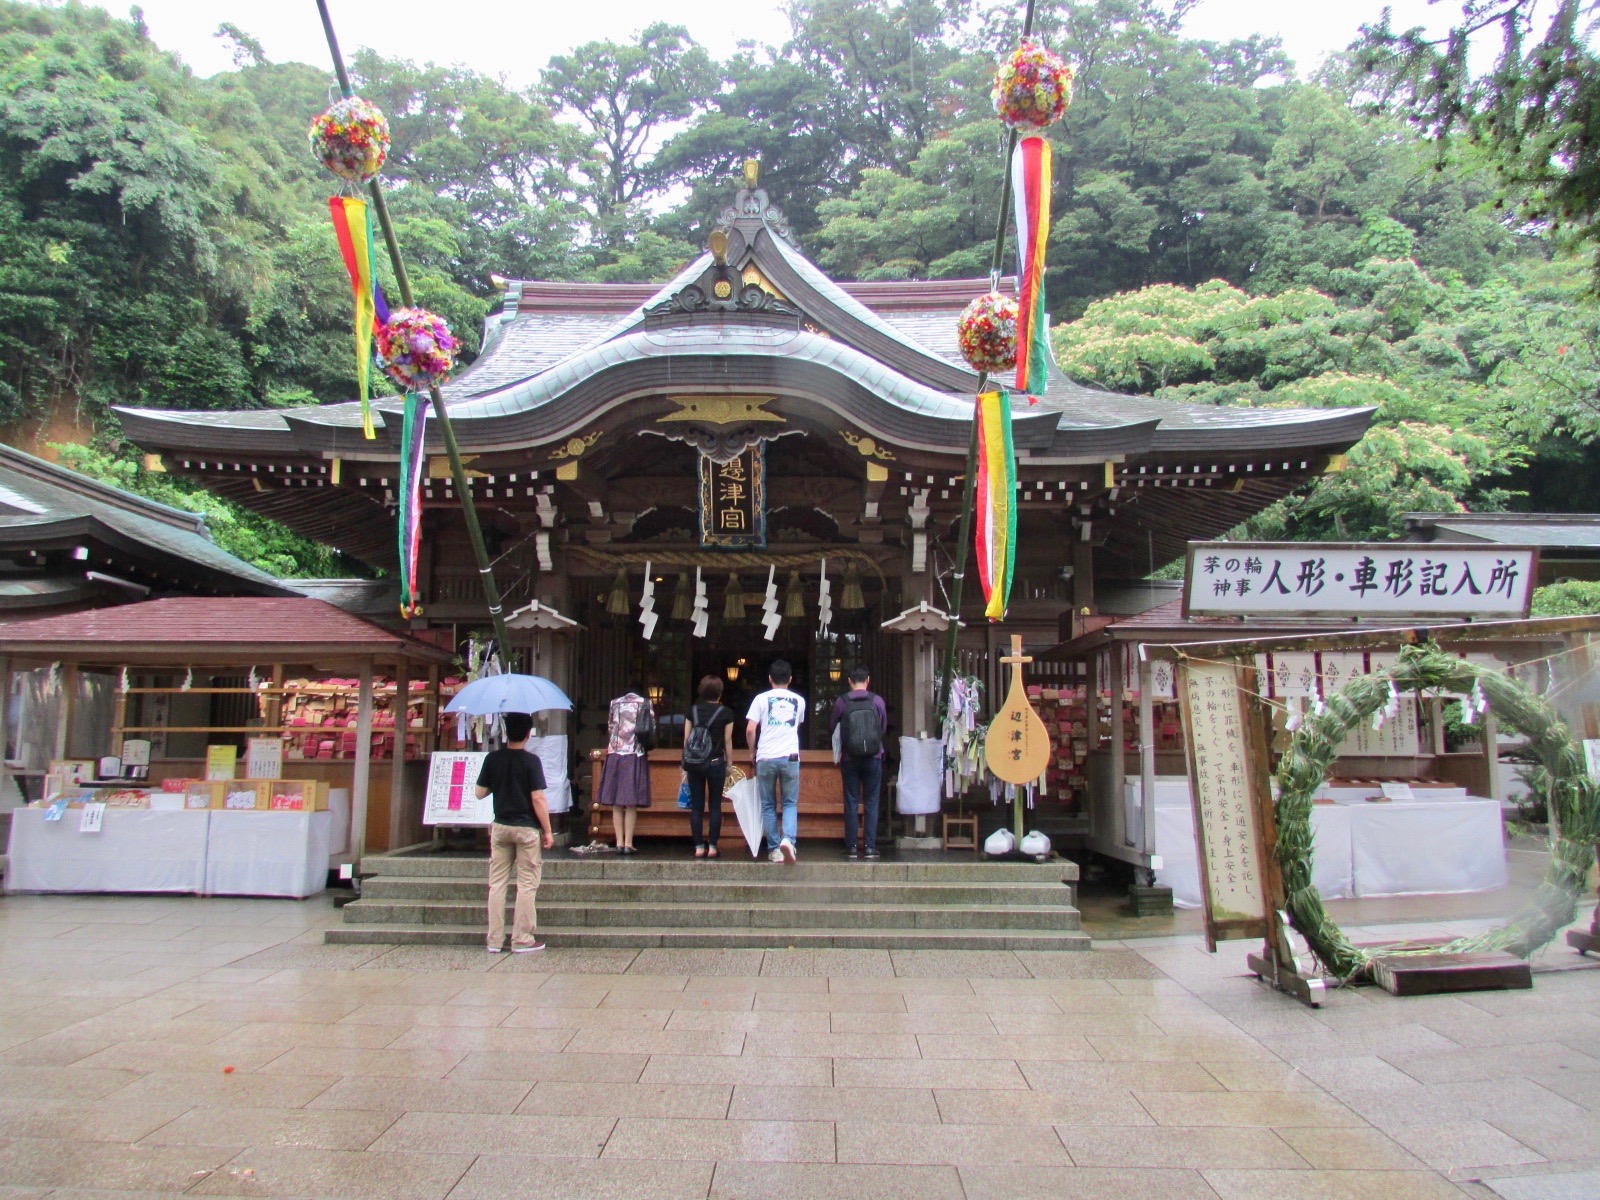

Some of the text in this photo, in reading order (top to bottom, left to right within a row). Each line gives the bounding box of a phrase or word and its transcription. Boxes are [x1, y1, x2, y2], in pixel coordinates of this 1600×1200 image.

[1203, 555, 1263, 574] 茅の輪
[1260, 556, 1519, 600] 人形・車形記入所
[1212, 578, 1252, 597] 神事
[1010, 711, 1022, 761] 辺津宮
